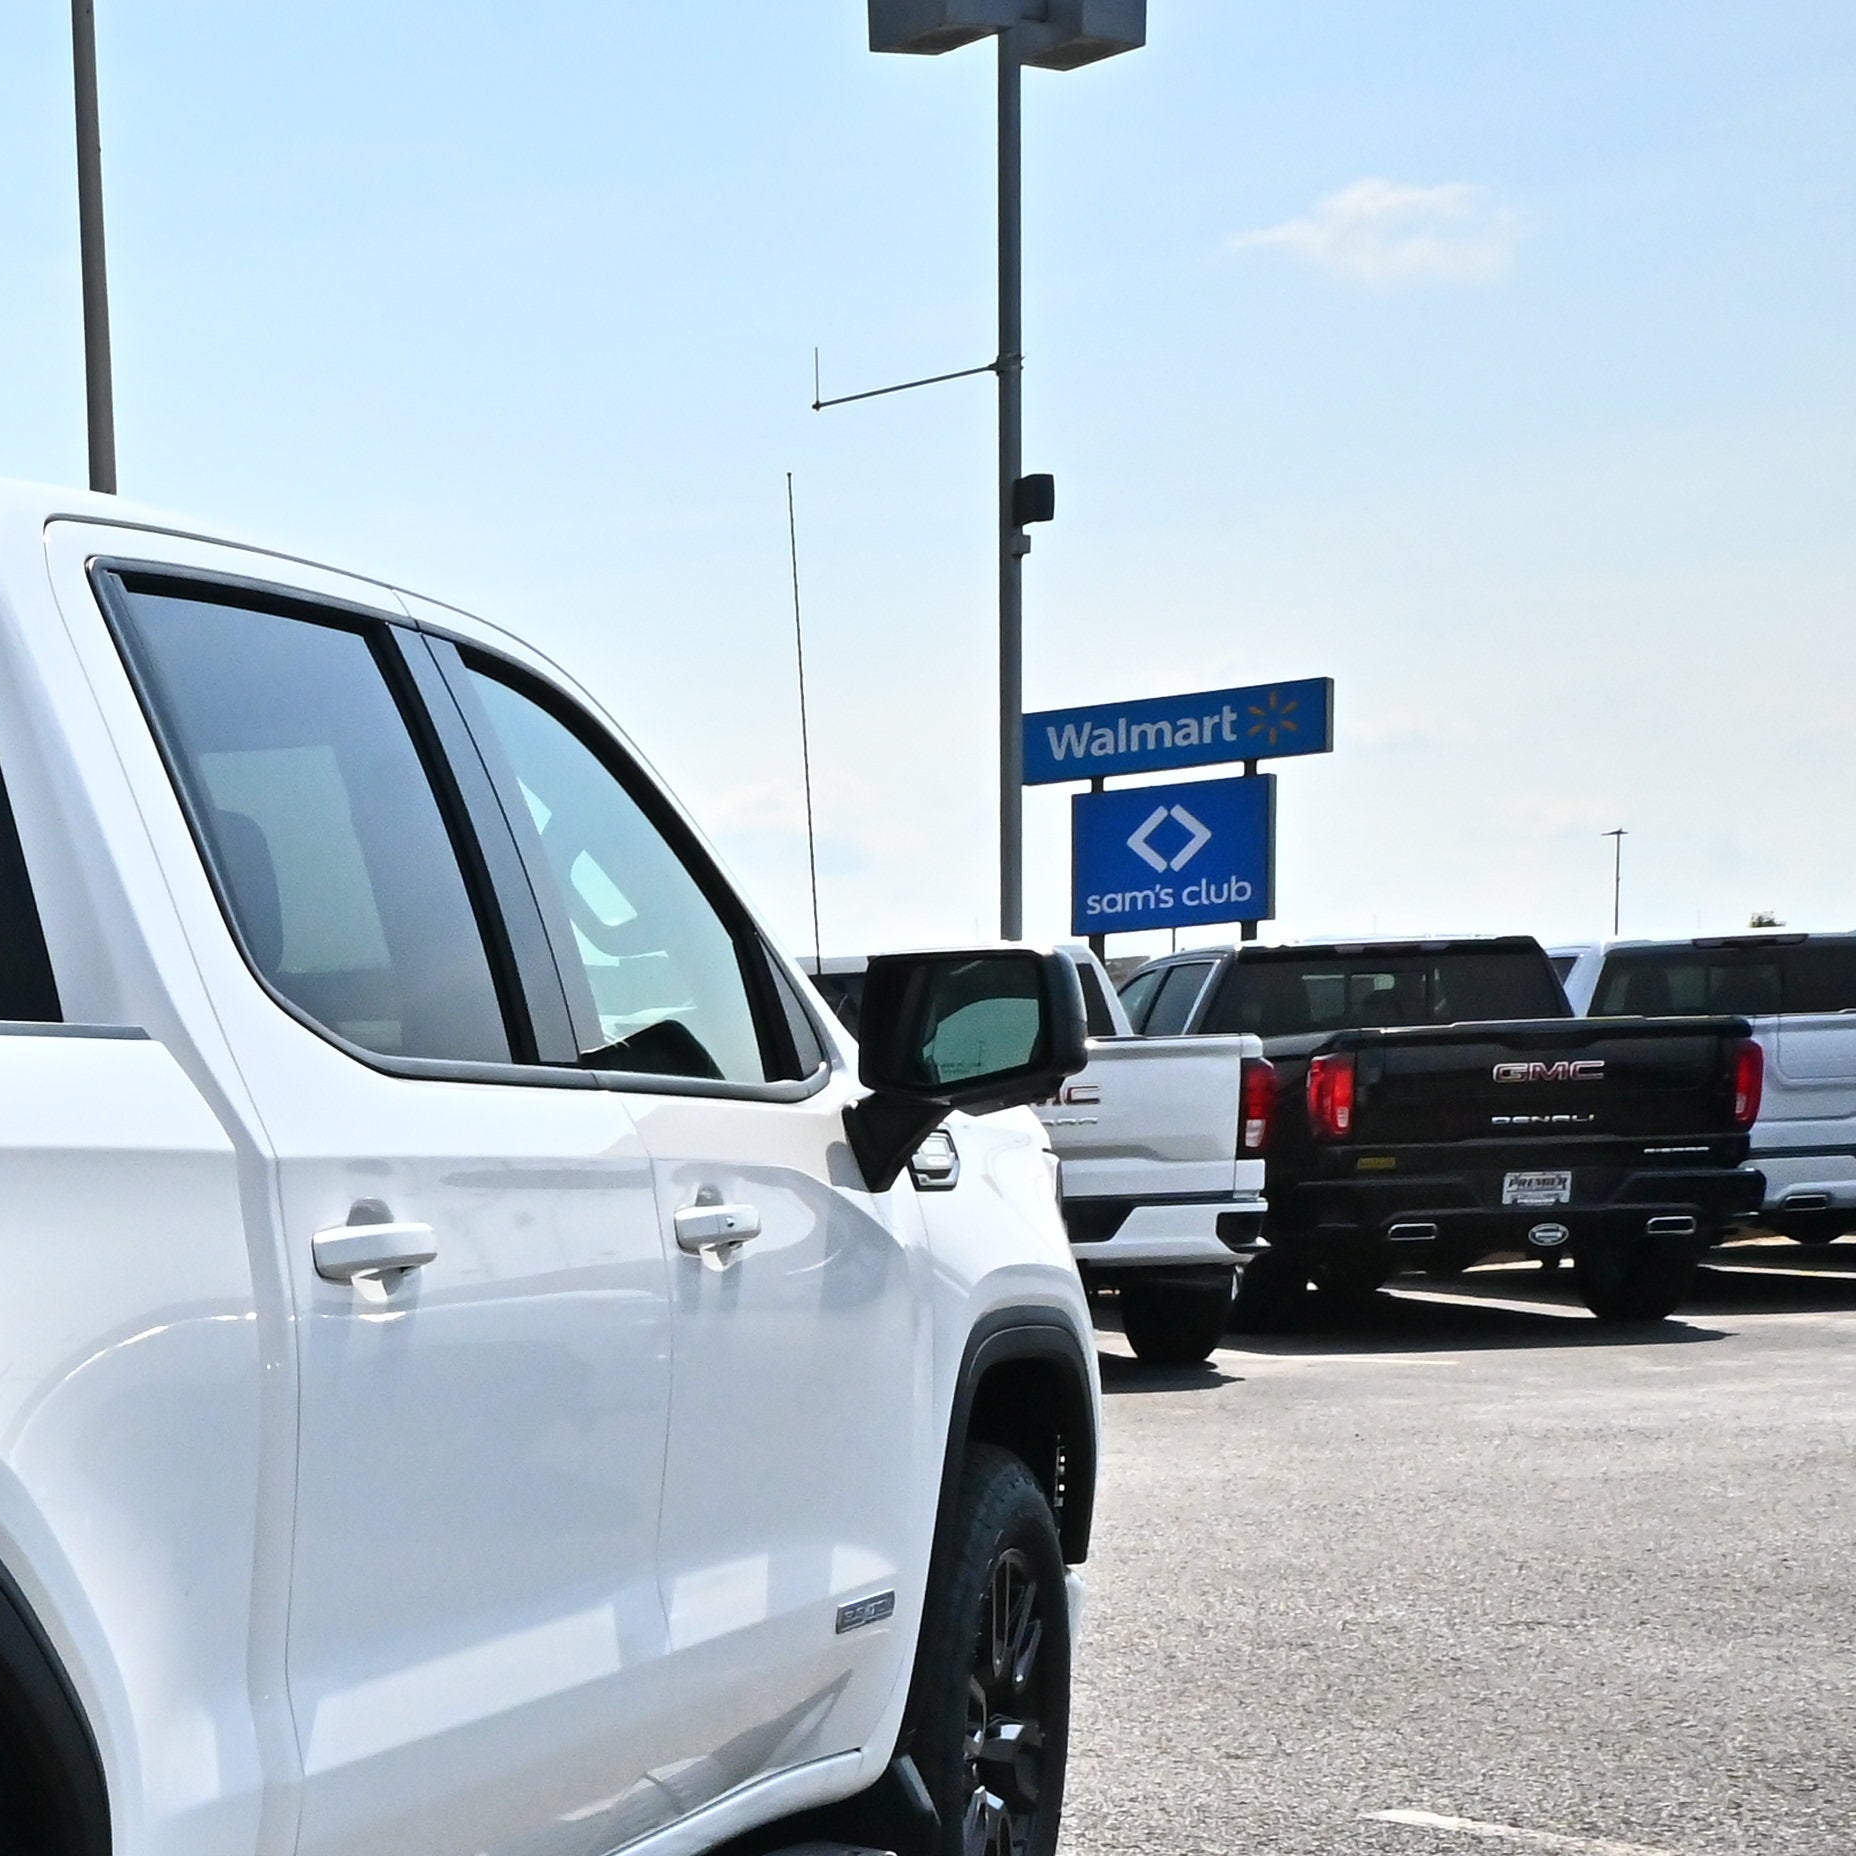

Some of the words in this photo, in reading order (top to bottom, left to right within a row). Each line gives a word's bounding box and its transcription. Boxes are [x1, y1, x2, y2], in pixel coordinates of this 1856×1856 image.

[1046, 705, 1238, 761] Walmart
[1086, 883, 1175, 915] sam's
[1181, 875, 1253, 906] club
[1493, 1060, 1605, 1083] GMC
[1491, 1114, 1595, 1125] DENALI
